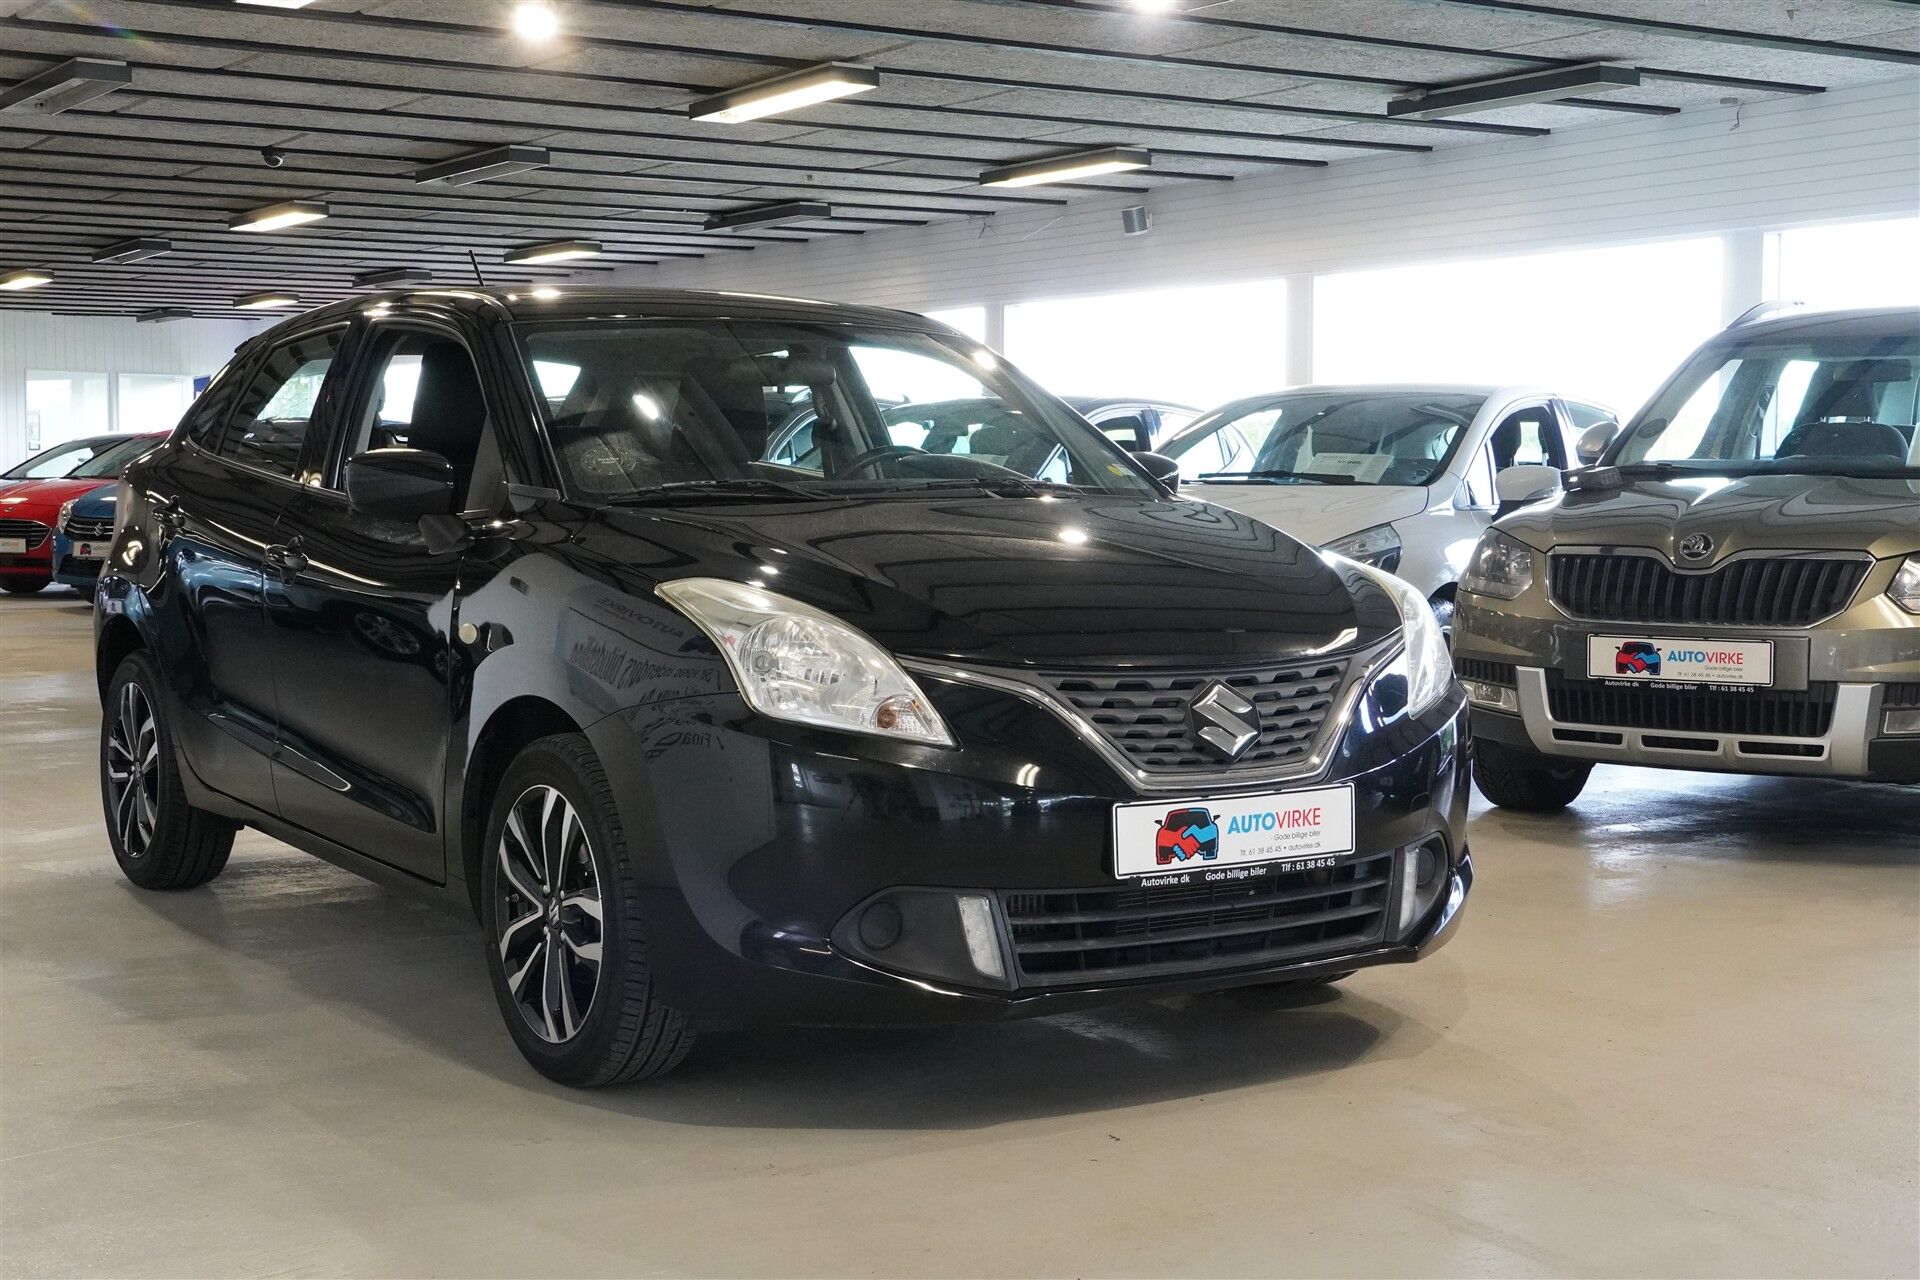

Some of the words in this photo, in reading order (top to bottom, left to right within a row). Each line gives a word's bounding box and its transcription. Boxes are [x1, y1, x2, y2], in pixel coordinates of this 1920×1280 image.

[1667, 650, 1744, 665] AUTOVIRKE
[1227, 808, 1321, 834] AUTOVIRKE
[1291, 831, 1308, 840] billige
[1288, 842, 1321, 851] autovirke.dk
[1141, 876, 1178, 887] Autovirke
[1180, 874, 1190, 883] dk
[1205, 871, 1225, 881] Gode
[1227, 868, 1249, 881] billige
[1250, 867, 1267, 877] biler
[1296, 861, 1305, 870] 61
[1306, 860, 1315, 869] 38
[1316, 859, 1326, 868] 45
[1326, 858, 1335, 867] 45
